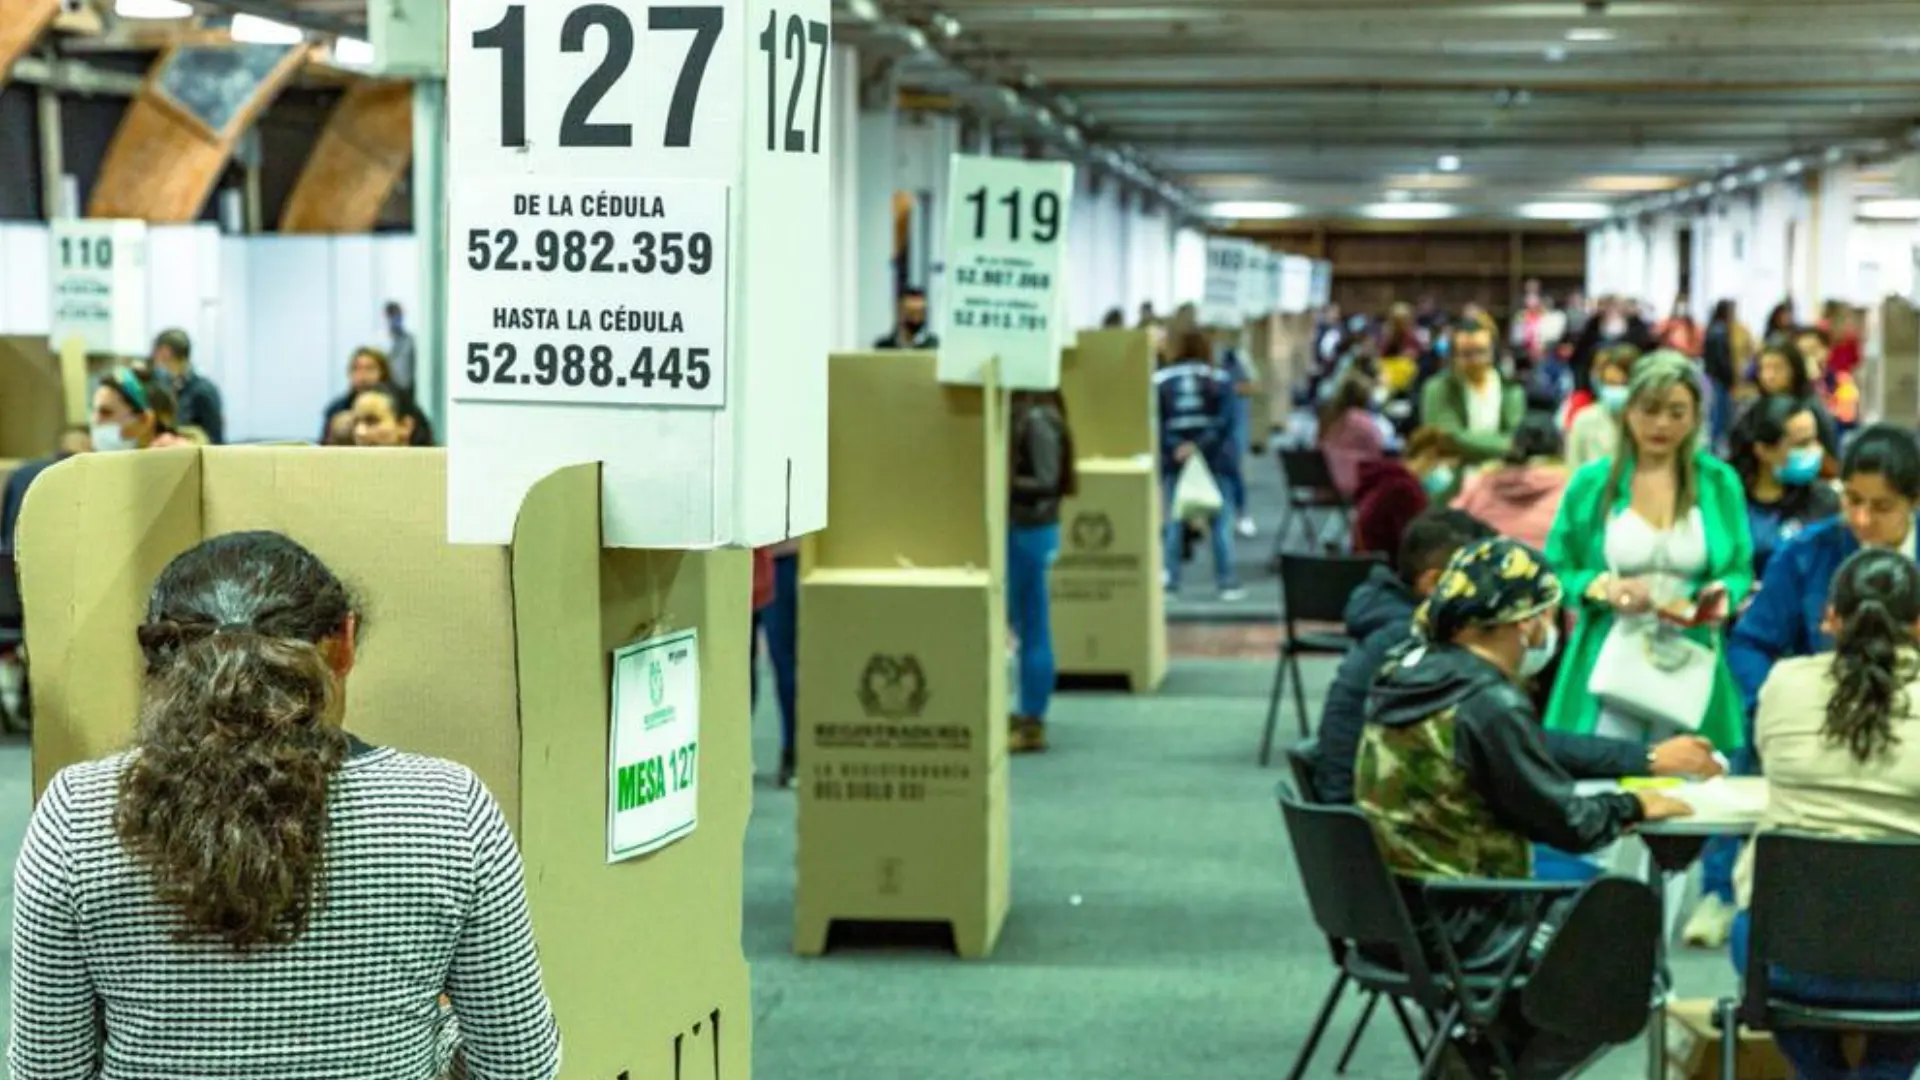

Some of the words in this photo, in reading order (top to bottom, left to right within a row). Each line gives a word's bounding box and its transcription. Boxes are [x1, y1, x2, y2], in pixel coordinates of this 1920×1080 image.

[472, 3, 724, 147] 127
[760, 9, 828, 153] 127
[514, 194, 540, 216] DE
[548, 195, 573, 217] LA
[581, 190, 665, 218] CÉDULA
[965, 185, 1060, 244] 119
[60, 236, 112, 268] 110
[468, 228, 713, 275] 52.982.359
[493, 307, 559, 330] HASTA
[567, 309, 592, 331] LA
[600, 304, 684, 333] CÉDULA
[466, 342, 711, 390] 52.988.445
[617, 755, 665, 812] MESA
[669, 743, 697, 792] 127
